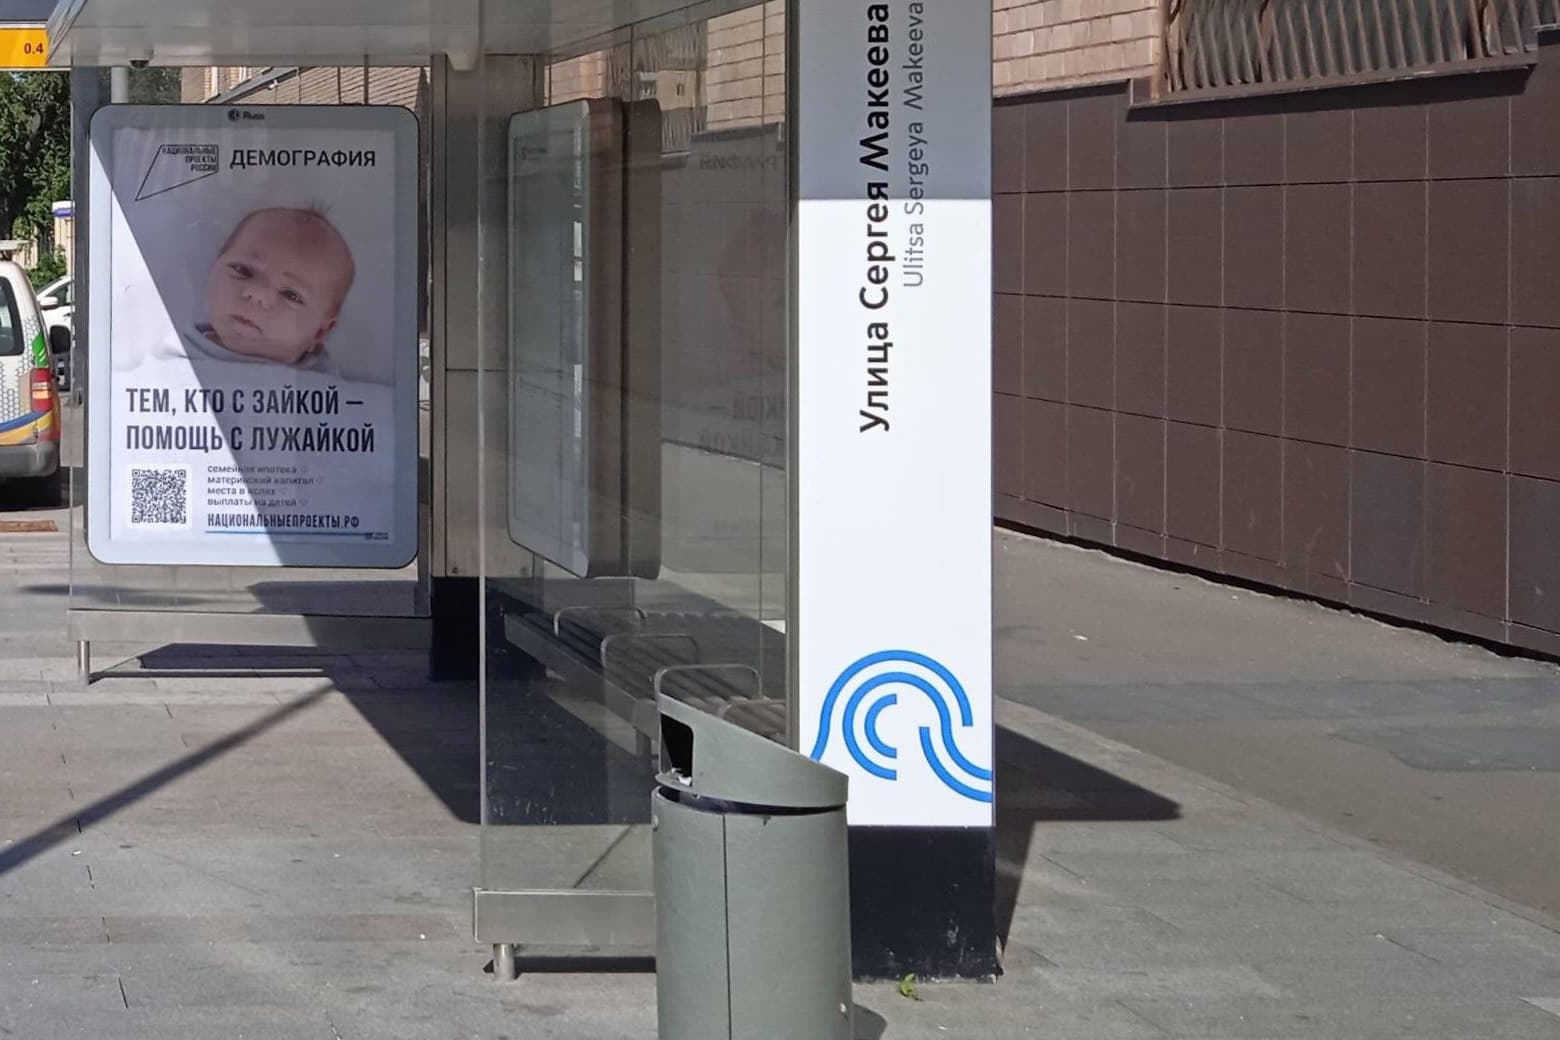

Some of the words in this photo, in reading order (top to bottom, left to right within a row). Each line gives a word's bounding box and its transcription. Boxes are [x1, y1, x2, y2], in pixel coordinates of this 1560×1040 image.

[24, 43, 44, 54] 0.4
[903, 1, 924, 111] Makeeva
[859, 3, 889, 171] Макеева
[229, 149, 376, 170] ДЕМОГРАФИЯ
[904, 121, 929, 216] Sergeya
[859, 182, 896, 310] Сергея
[903, 222, 924, 287] Ulitsa
[860, 321, 893, 433] Улица
[126, 388, 177, 416] ТЕМ,
[184, 388, 225, 414] КТО
[231, 389, 245, 414] С
[252, 385, 340, 415] ЗАЙКОЙ
[126, 424, 224, 453] ПОМОЩЬ
[230, 426, 244, 451] С
[250, 423, 376, 453] ЛУЖАЙКОЙ
[207, 464, 255, 474] семейная
[257, 465, 297, 474] ипотека
[207, 487, 237, 495] места
[239, 488, 246, 496] в
[207, 498, 253, 506] выплаты
[254, 499, 267, 507] на
[207, 513, 360, 529] НАЦИОНАЛЬНЫЕПРОЕКТЫ.РФ
